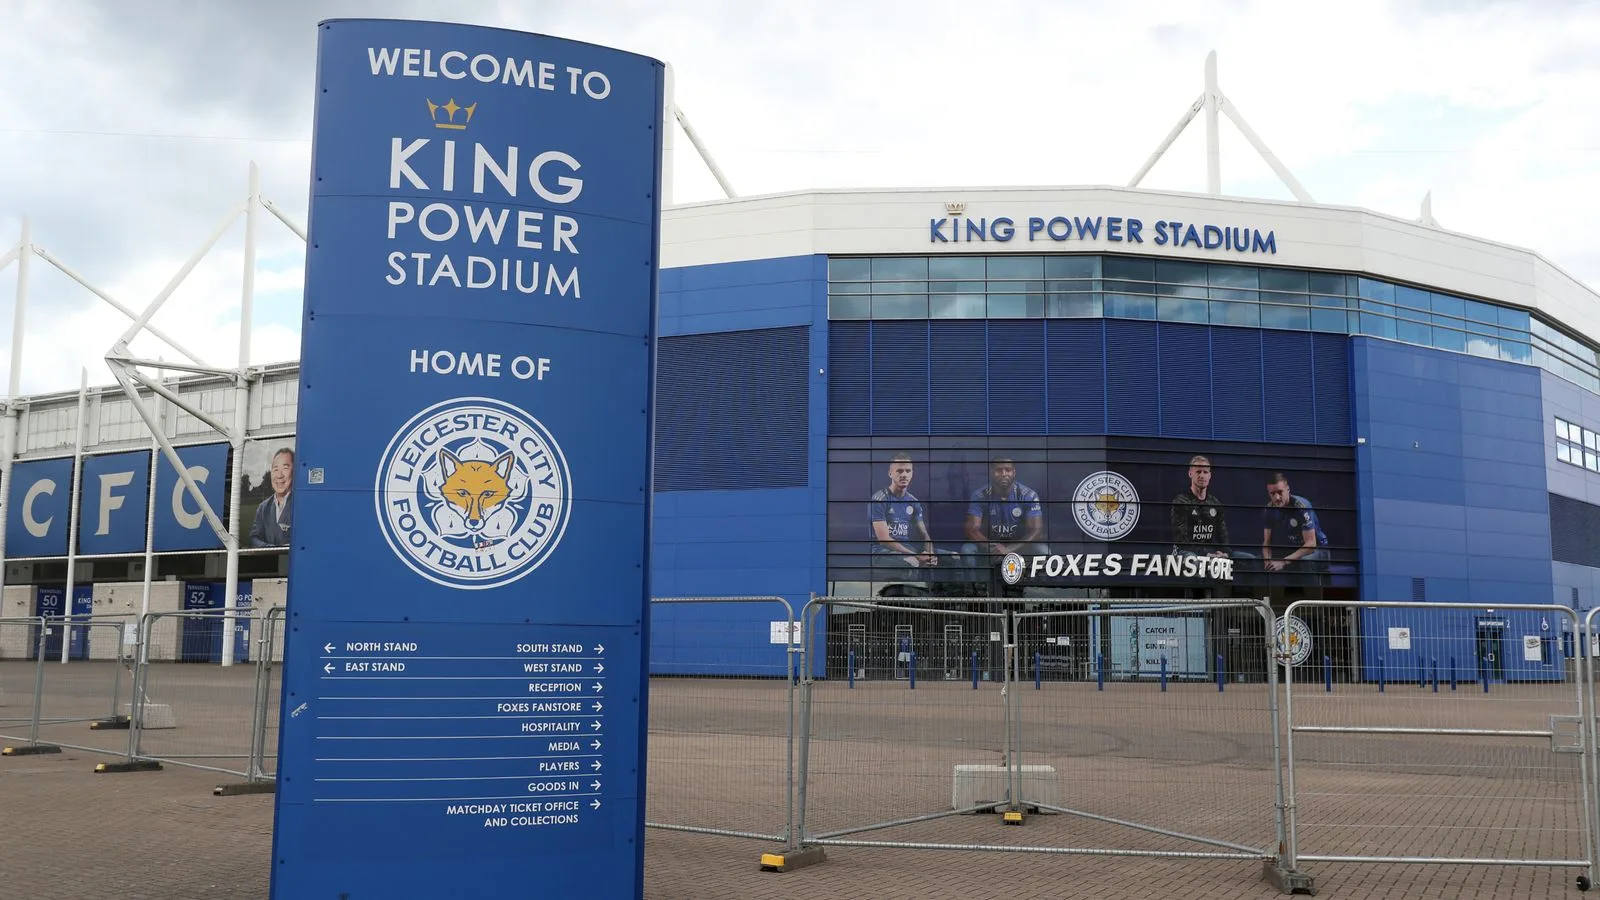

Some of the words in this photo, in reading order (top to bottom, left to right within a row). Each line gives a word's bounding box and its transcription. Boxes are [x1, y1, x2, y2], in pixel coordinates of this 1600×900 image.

[368, 47, 556, 91] WELCOME
[566, 66, 611, 100] TO
[389, 137, 584, 204] KING
[387, 201, 580, 255] POWER
[930, 216, 1016, 243] KING
[1028, 216, 1144, 244] POWER
[1153, 220, 1278, 255] STADIUM
[385, 251, 581, 299] STADIUM
[410, 350, 501, 377] HOME
[510, 356, 551, 381] OF
[395, 413, 520, 483] LEICESTER
[519, 436, 556, 490] CITY
[1080, 476, 1121, 503] EICESTER
[22, 478, 57, 538] C
[94, 470, 135, 536] F
[171, 465, 210, 530] C
[1078, 508, 1119, 535] FOOTBALL
[1119, 508, 1135, 531] CLUB
[1193, 524, 1214, 533] KING
[393, 497, 507, 573] FOOTBALL
[507, 502, 555, 561] CLUB
[1030, 553, 1123, 578] FOXES
[1130, 554, 1234, 580] FANSTORE
[42, 594, 58, 607] 50
[190, 591, 206, 604] 52
[346, 642, 381, 652] NORTH
[383, 642, 418, 652] STAND
[516, 643, 549, 653] SOUTH
[551, 643, 583, 653] STAND
[345, 662, 369, 672] EAST
[371, 662, 406, 672] STAND
[523, 663, 549, 673] WEST
[550, 663, 583, 673] STAND
[528, 682, 582, 693] RECEPTION
[497, 702, 530, 713] FOXES
[532, 702, 582, 712] FANSTORE
[521, 721, 581, 732] HOSPITALITY
[548, 741, 580, 752] MEDIA
[539, 761, 580, 772] PLAYERS
[527, 781, 567, 792] GOODS
[568, 781, 579, 791] IN
[446, 804, 507, 815] MATCHDAY
[509, 802, 543, 813] TICKET
[544, 800, 579, 812] OFFICE
[484, 817, 508, 828] AND
[510, 814, 579, 827] COLLECTIONS
